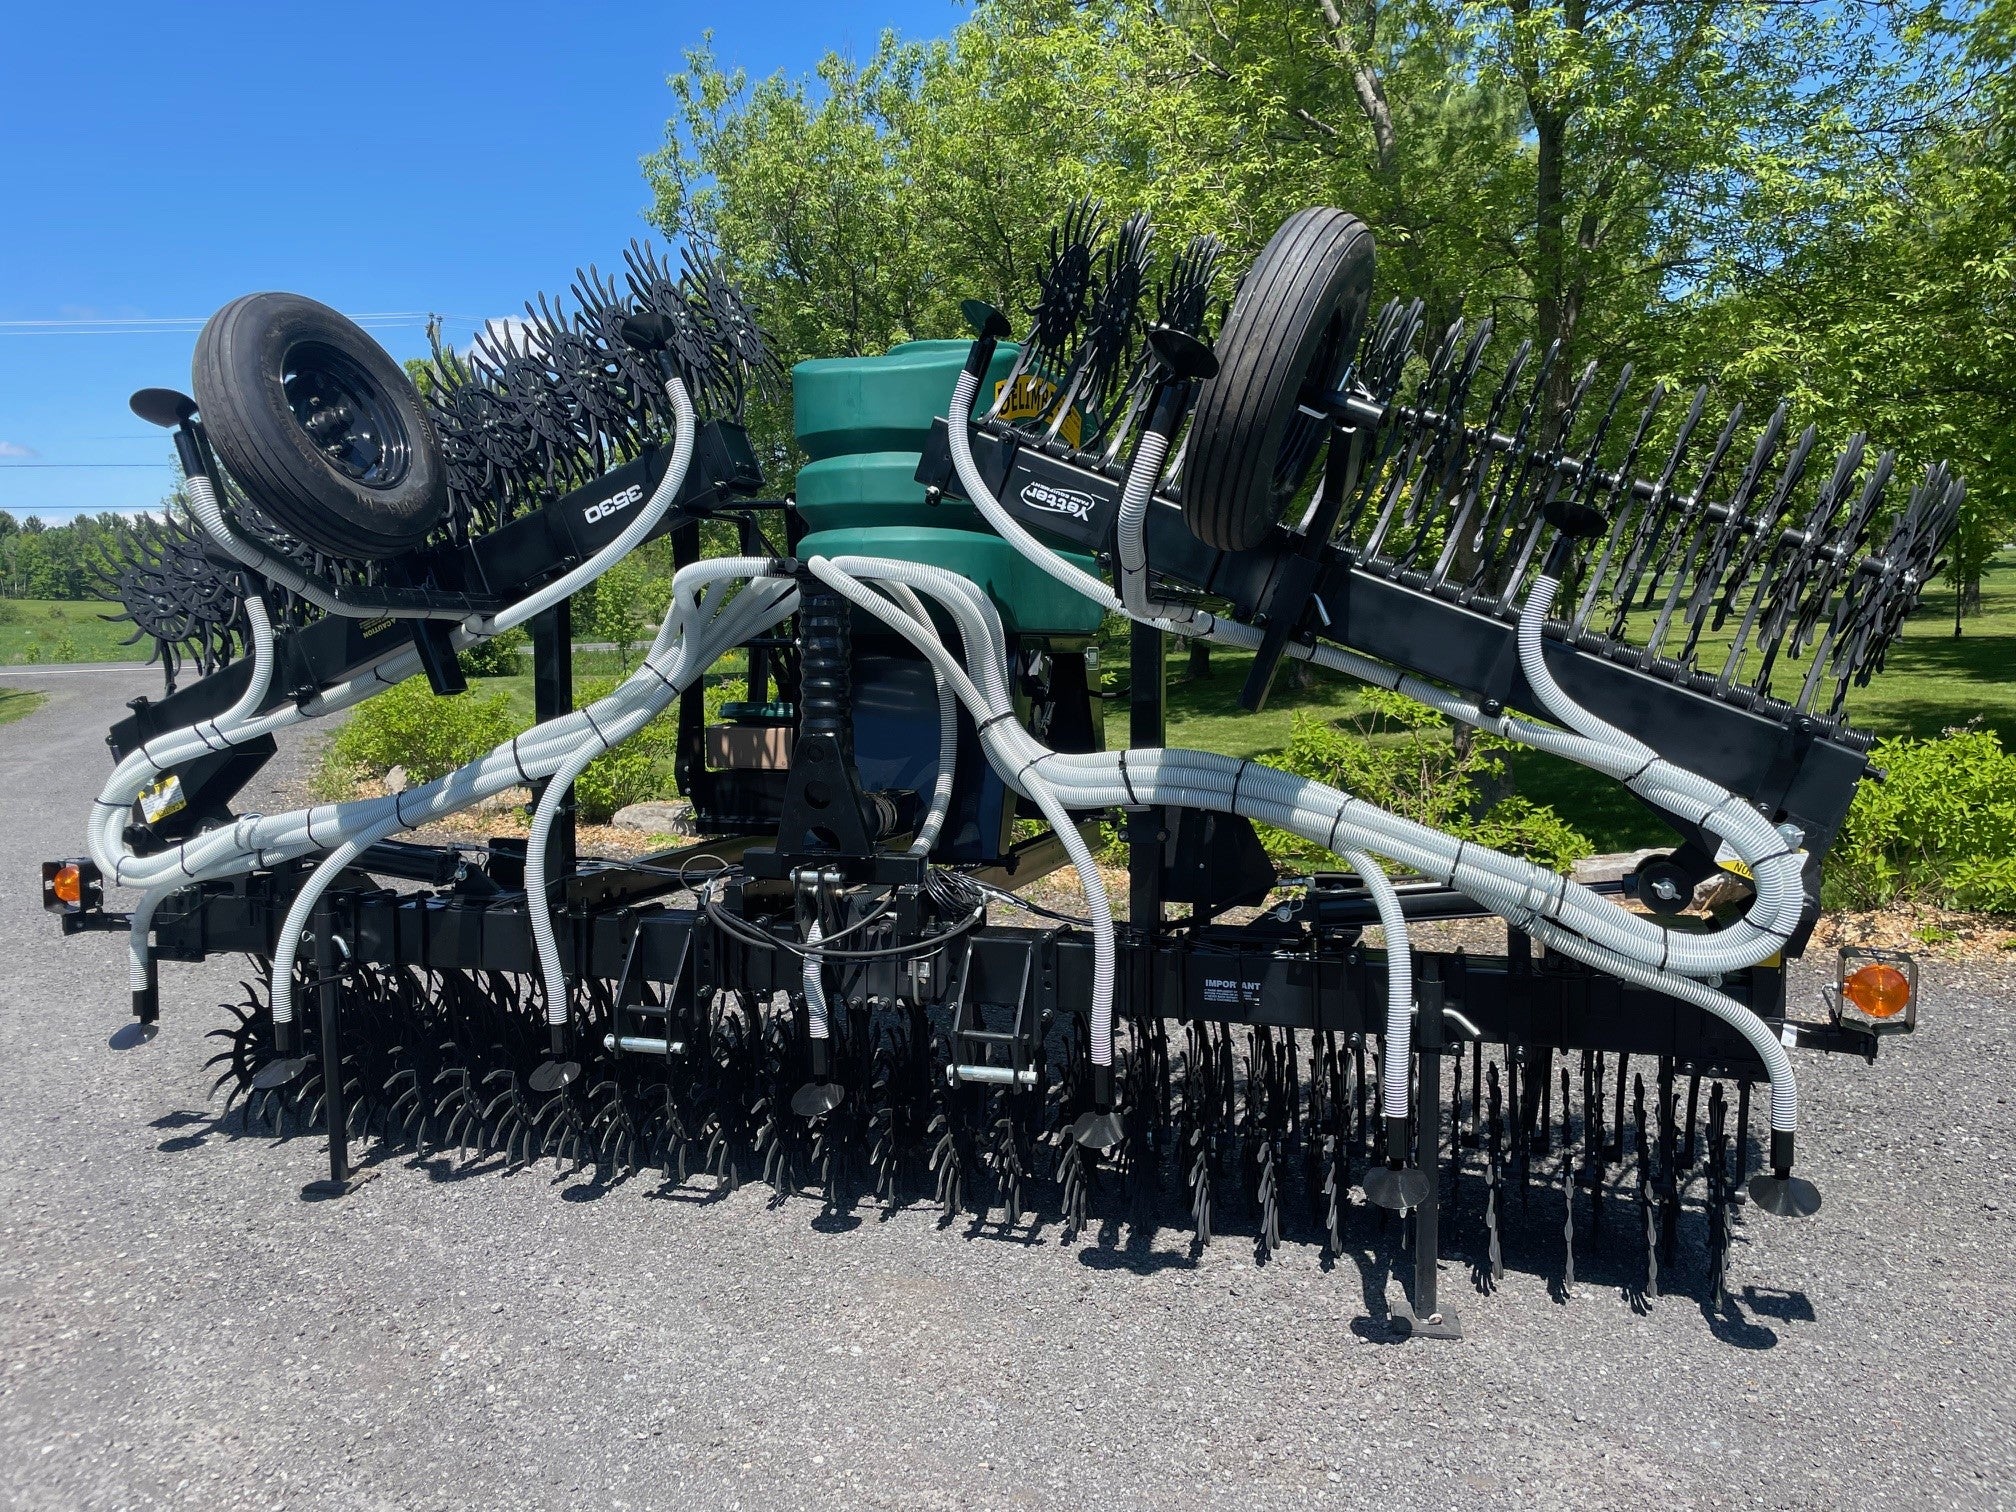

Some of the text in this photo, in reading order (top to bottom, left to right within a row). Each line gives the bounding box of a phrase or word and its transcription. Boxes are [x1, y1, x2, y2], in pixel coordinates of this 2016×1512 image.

[585, 484, 644, 524] 3530
[1026, 487, 1089, 522] Yetter
[1070, 495, 1090, 507] FARM
[362, 620, 392, 640] CAUTION
[1205, 979, 1261, 990] IMPORANT
